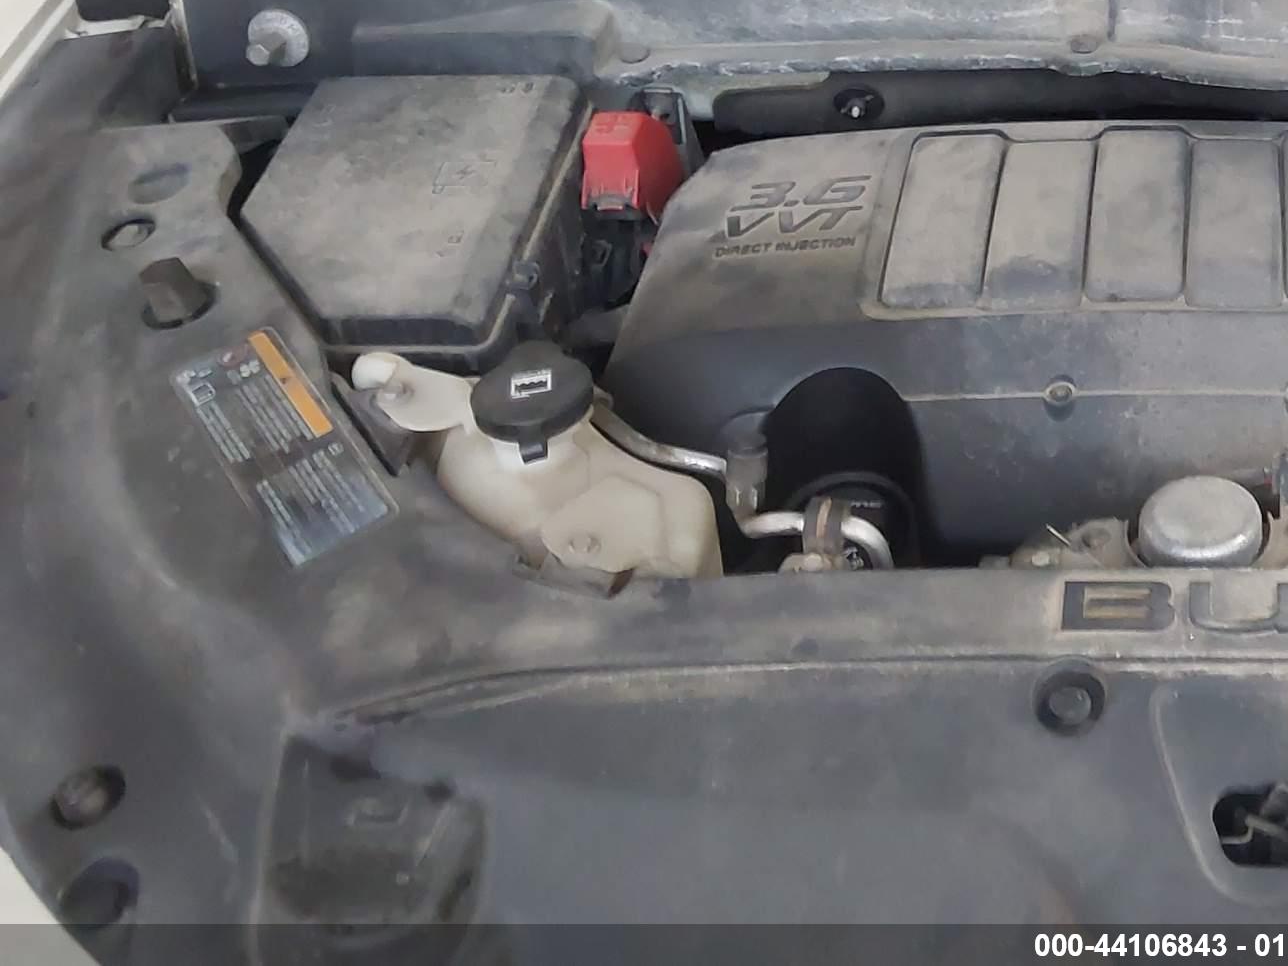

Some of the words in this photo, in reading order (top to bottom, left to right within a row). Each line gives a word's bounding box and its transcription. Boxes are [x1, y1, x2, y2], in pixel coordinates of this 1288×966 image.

[729, 174, 873, 213] 3.6
[726, 205, 864, 238] VVT
[714, 241, 773, 258] DIRECT
[775, 236, 857, 252] INJECTION
